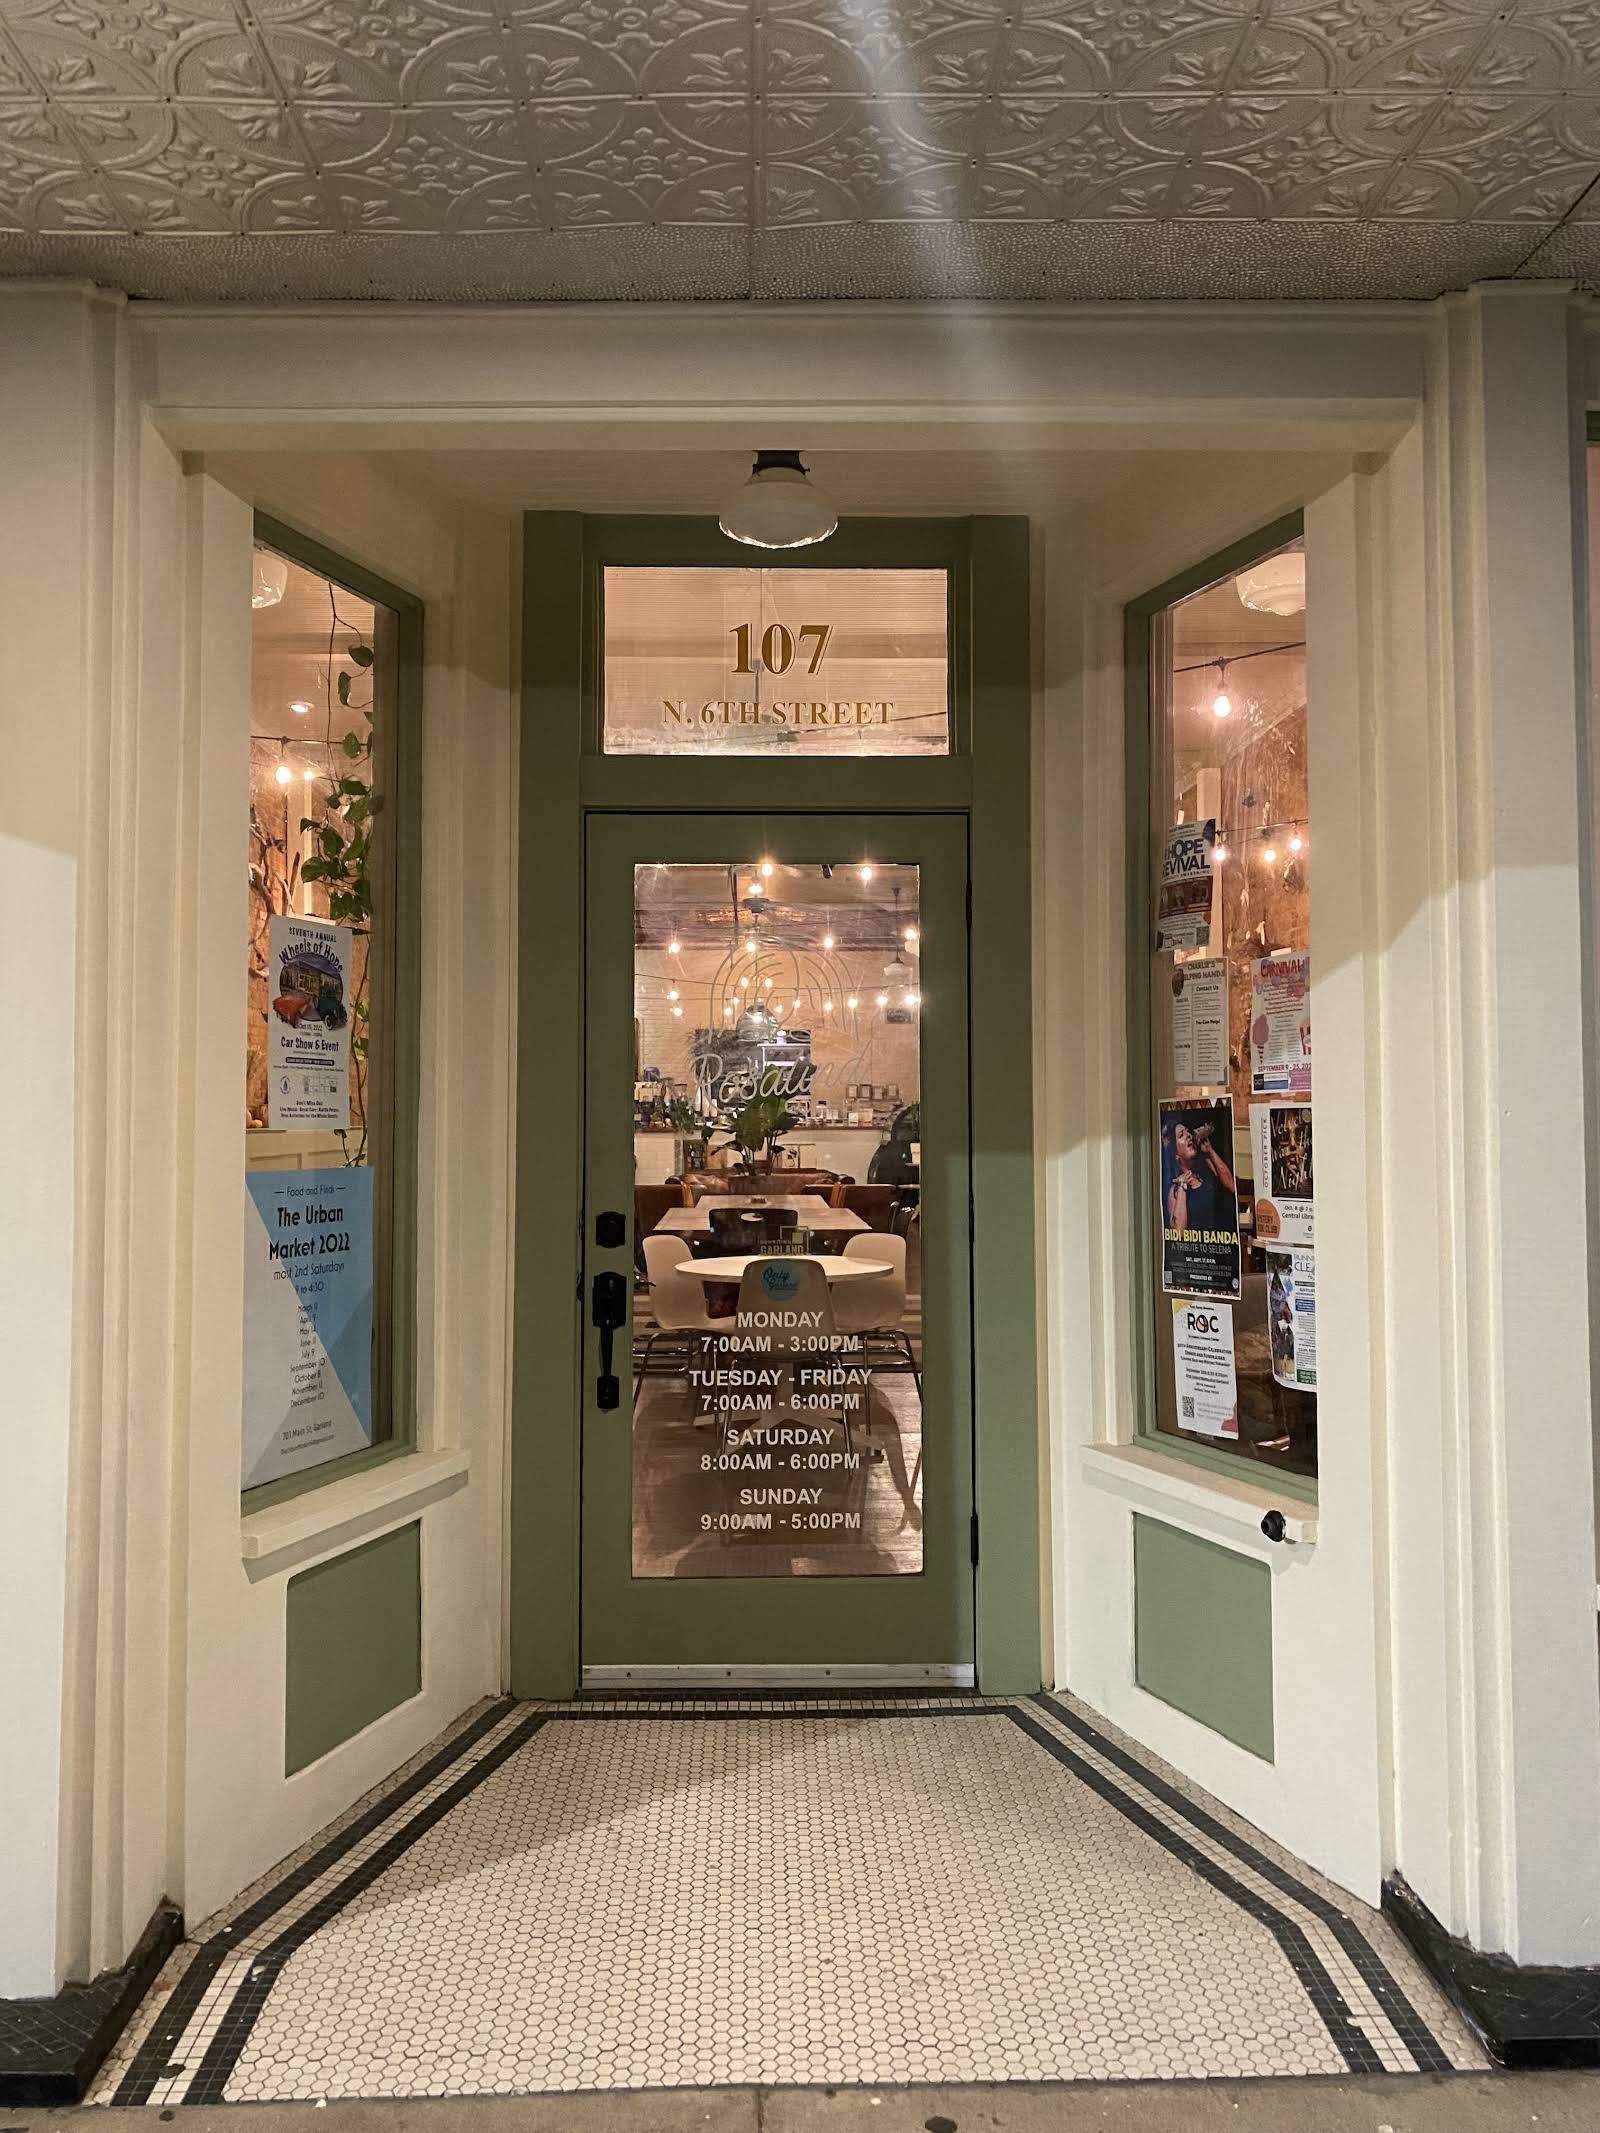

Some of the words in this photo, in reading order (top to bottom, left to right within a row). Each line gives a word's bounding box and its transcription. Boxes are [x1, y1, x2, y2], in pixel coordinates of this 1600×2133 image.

[729, 622, 834, 676] 107
[662, 700, 693, 725] N.
[701, 700, 761, 726] 6TH
[771, 700, 895, 726] STREET
[289, 926, 314, 938] SEVENTH
[316, 932, 336, 942] ANNUAL
[279, 938, 311, 964] Wheels
[313, 941, 323, 955] of
[324, 944, 343, 973] Hope
[281, 1036, 293, 1048] Car
[295, 1036, 314, 1050] Show
[321, 1040, 339, 1051] Event
[286, 1186, 304, 1196] Food
[306, 1185, 318, 1196] and
[278, 1206, 300, 1227] The
[305, 1204, 343, 1224] Urban
[1164, 1228, 1181, 1241] BIDI
[1184, 1229, 1201, 1242] BIDI
[1203, 1230, 1238, 1244] BANDA
[269, 1238, 315, 1260] Market
[319, 1232, 350, 1254] 2022
[760, 1245, 804, 1256] GARLAND
[1176, 1243, 1198, 1252] TRIBUTE
[1200, 1244, 1208, 1253] TO
[1208, 1245, 1232, 1255] SELENA
[273, 1267, 292, 1280] most
[294, 1264, 309, 1278] 2nd
[311, 1261, 345, 1276] Saturdays
[737, 1312, 824, 1328] MONDAY
[1187, 1312, 1219, 1333] ROC
[701, 1336, 771, 1352] 7:00AM
[790, 1336, 859, 1352] 3:00PM
[290, 1362, 317, 1373] September
[294, 1372, 317, 1384] October
[689, 1369, 783, 1386] TUESDAY
[800, 1368, 873, 1386] FRIDAY
[292, 1384, 318, 1396] November
[290, 1396, 317, 1408] December
[702, 1394, 772, 1411] 7:00AM
[790, 1393, 860, 1410] 6:00PM
[293, 1428, 305, 1438] Main
[726, 1428, 834, 1446] SATURDAY
[700, 1453, 772, 1470] 8:00AM
[790, 1452, 860, 1470] 6:00PM
[740, 1488, 823, 1505] SUNDAY
[700, 1513, 772, 1530] 9:00AM
[791, 1512, 861, 1530] 5:00PM
